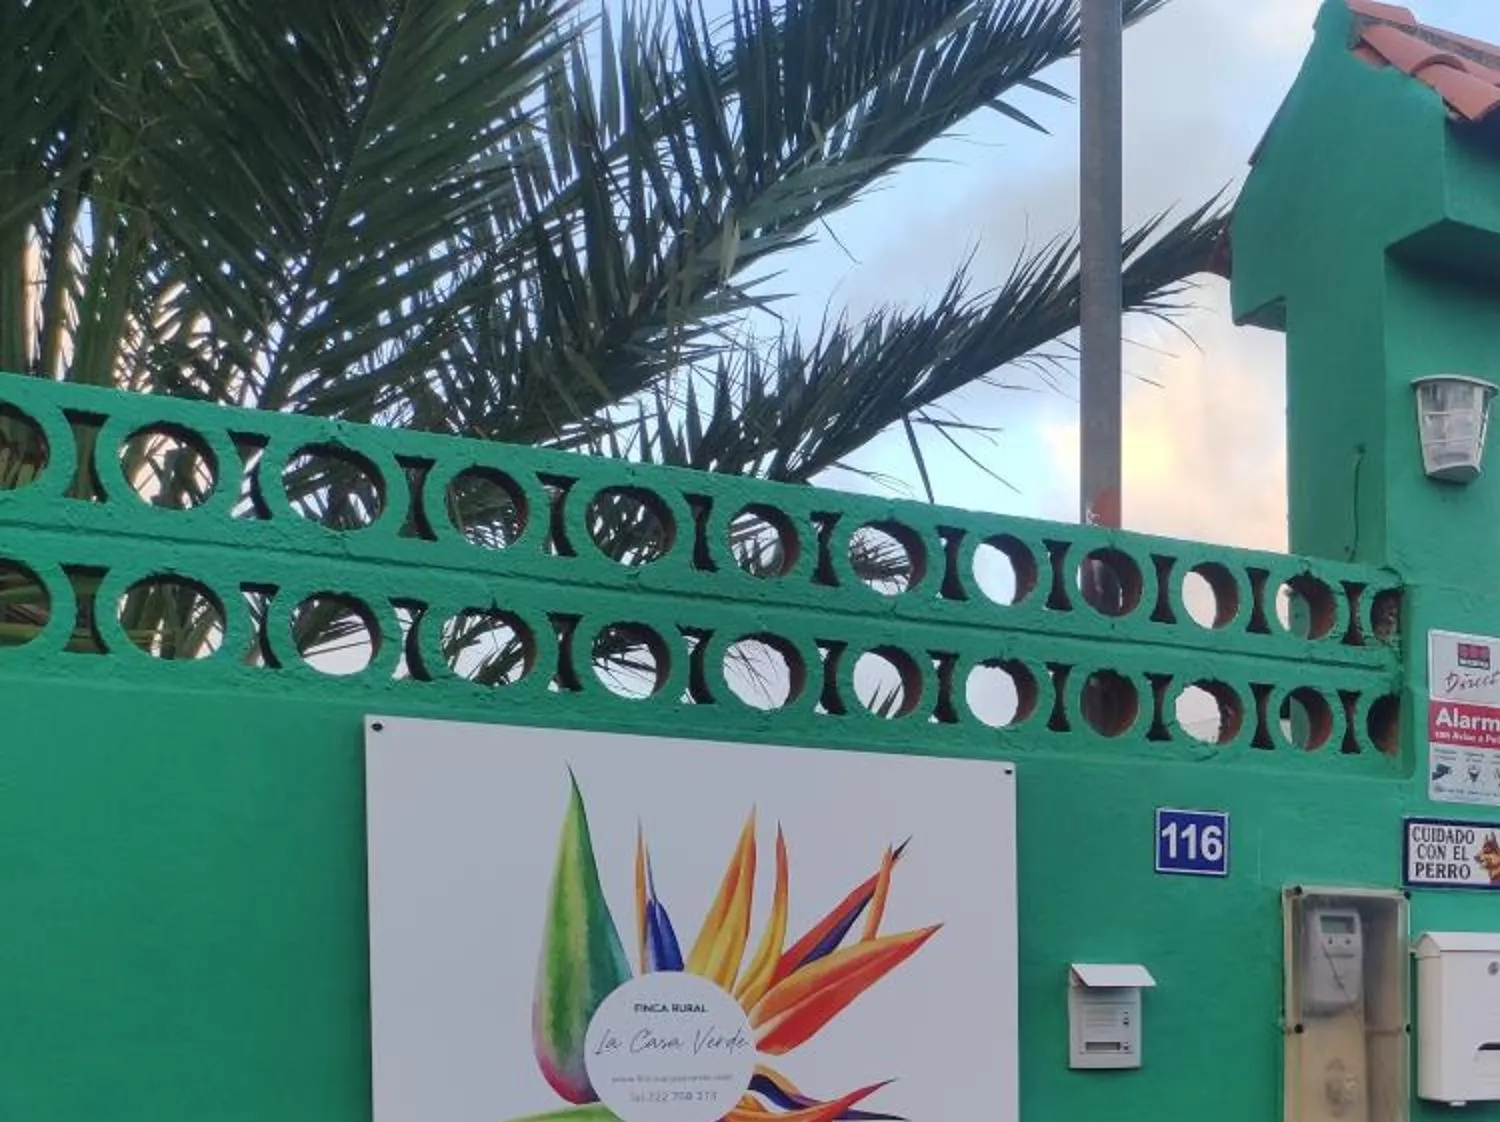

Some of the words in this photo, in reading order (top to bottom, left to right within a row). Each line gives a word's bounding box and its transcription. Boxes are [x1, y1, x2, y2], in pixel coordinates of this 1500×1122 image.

[1161, 821, 1223, 862] 116
[1411, 826, 1475, 845] CUIDADO
[1417, 843, 1446, 861] CON
[1453, 845, 1470, 861] EL
[1415, 862, 1471, 880] PERRO
[634, 1003, 669, 1013] FINCA
[671, 1003, 708, 1013] RURAL
[595, 1029, 622, 1056] La
[630, 1027, 684, 1053] Casa
[694, 1024, 749, 1055] Verde
